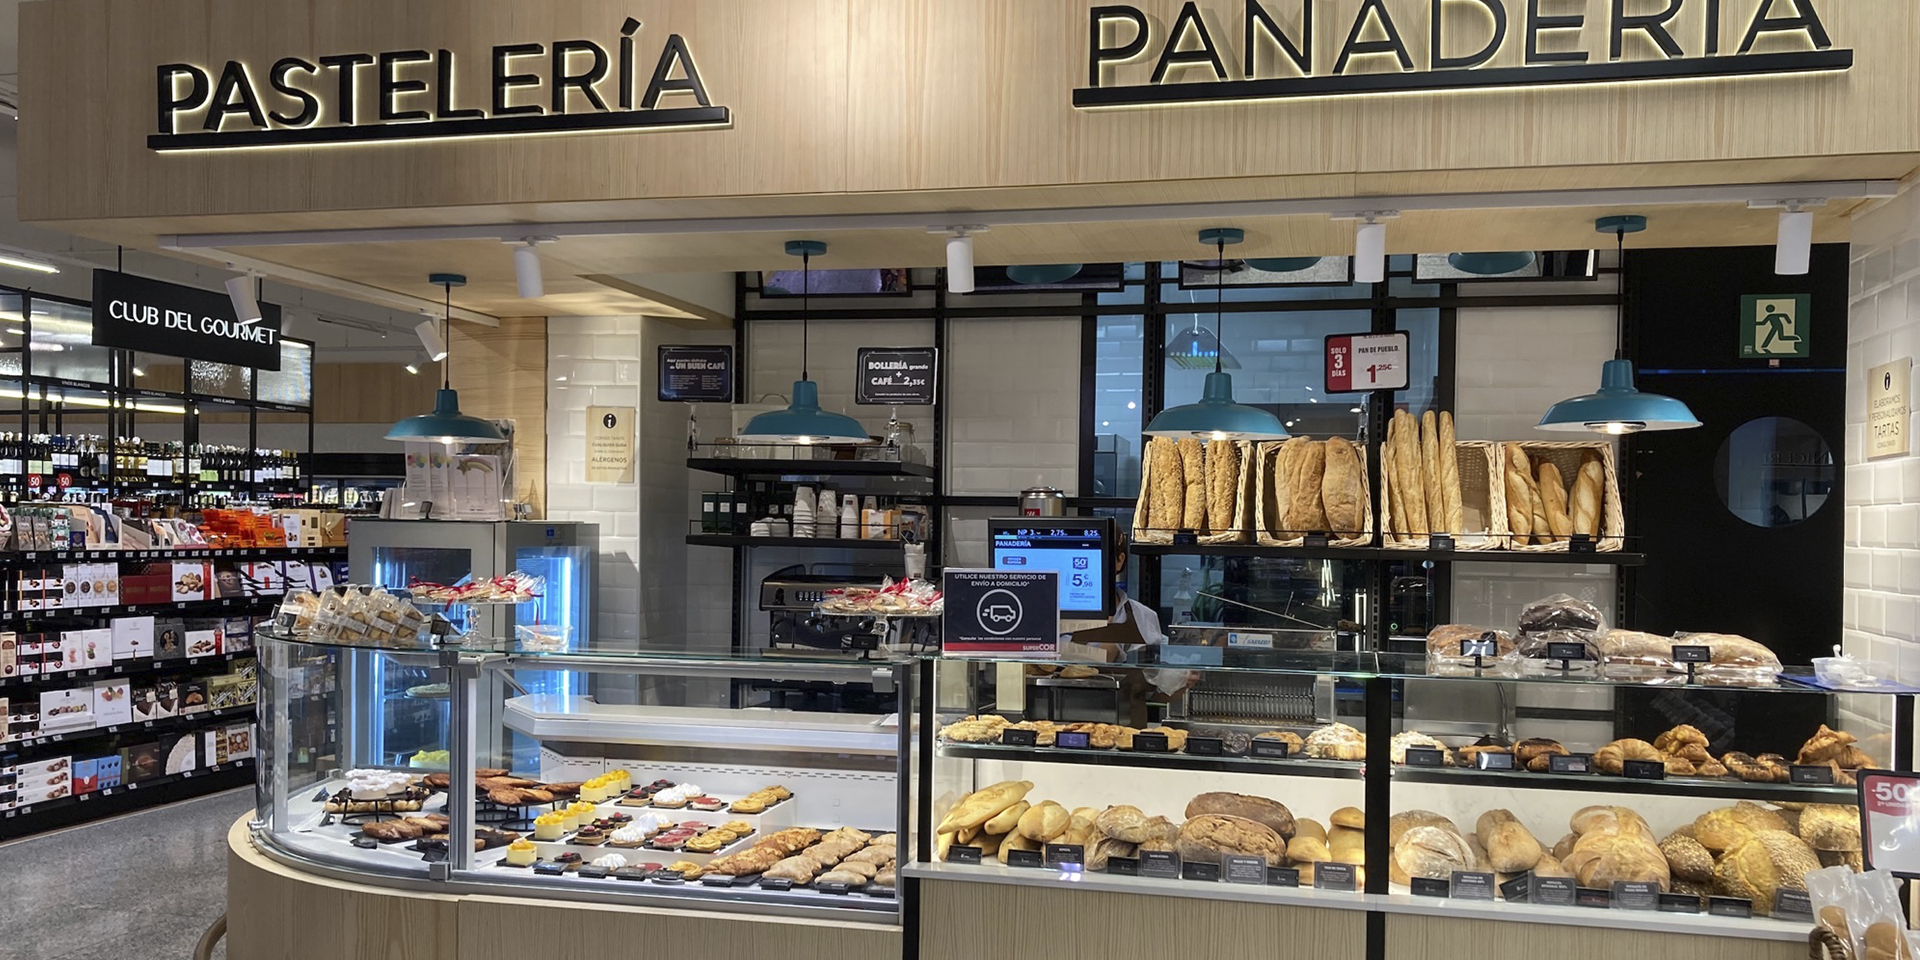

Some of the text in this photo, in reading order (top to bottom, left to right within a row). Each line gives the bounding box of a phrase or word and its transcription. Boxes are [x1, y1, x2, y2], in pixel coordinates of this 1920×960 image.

[157, 17, 712, 134] PASTELERÍA
[109, 300, 277, 345] CLUB DEL GOURMET
[868, 360, 908, 370] BOLLERÍA
[1334, 354, 1344, 369] 3
[871, 375, 893, 386] CAFÉ
[1331, 369, 1347, 377] DÍAS
[1874, 421, 1900, 439] TARTAS
